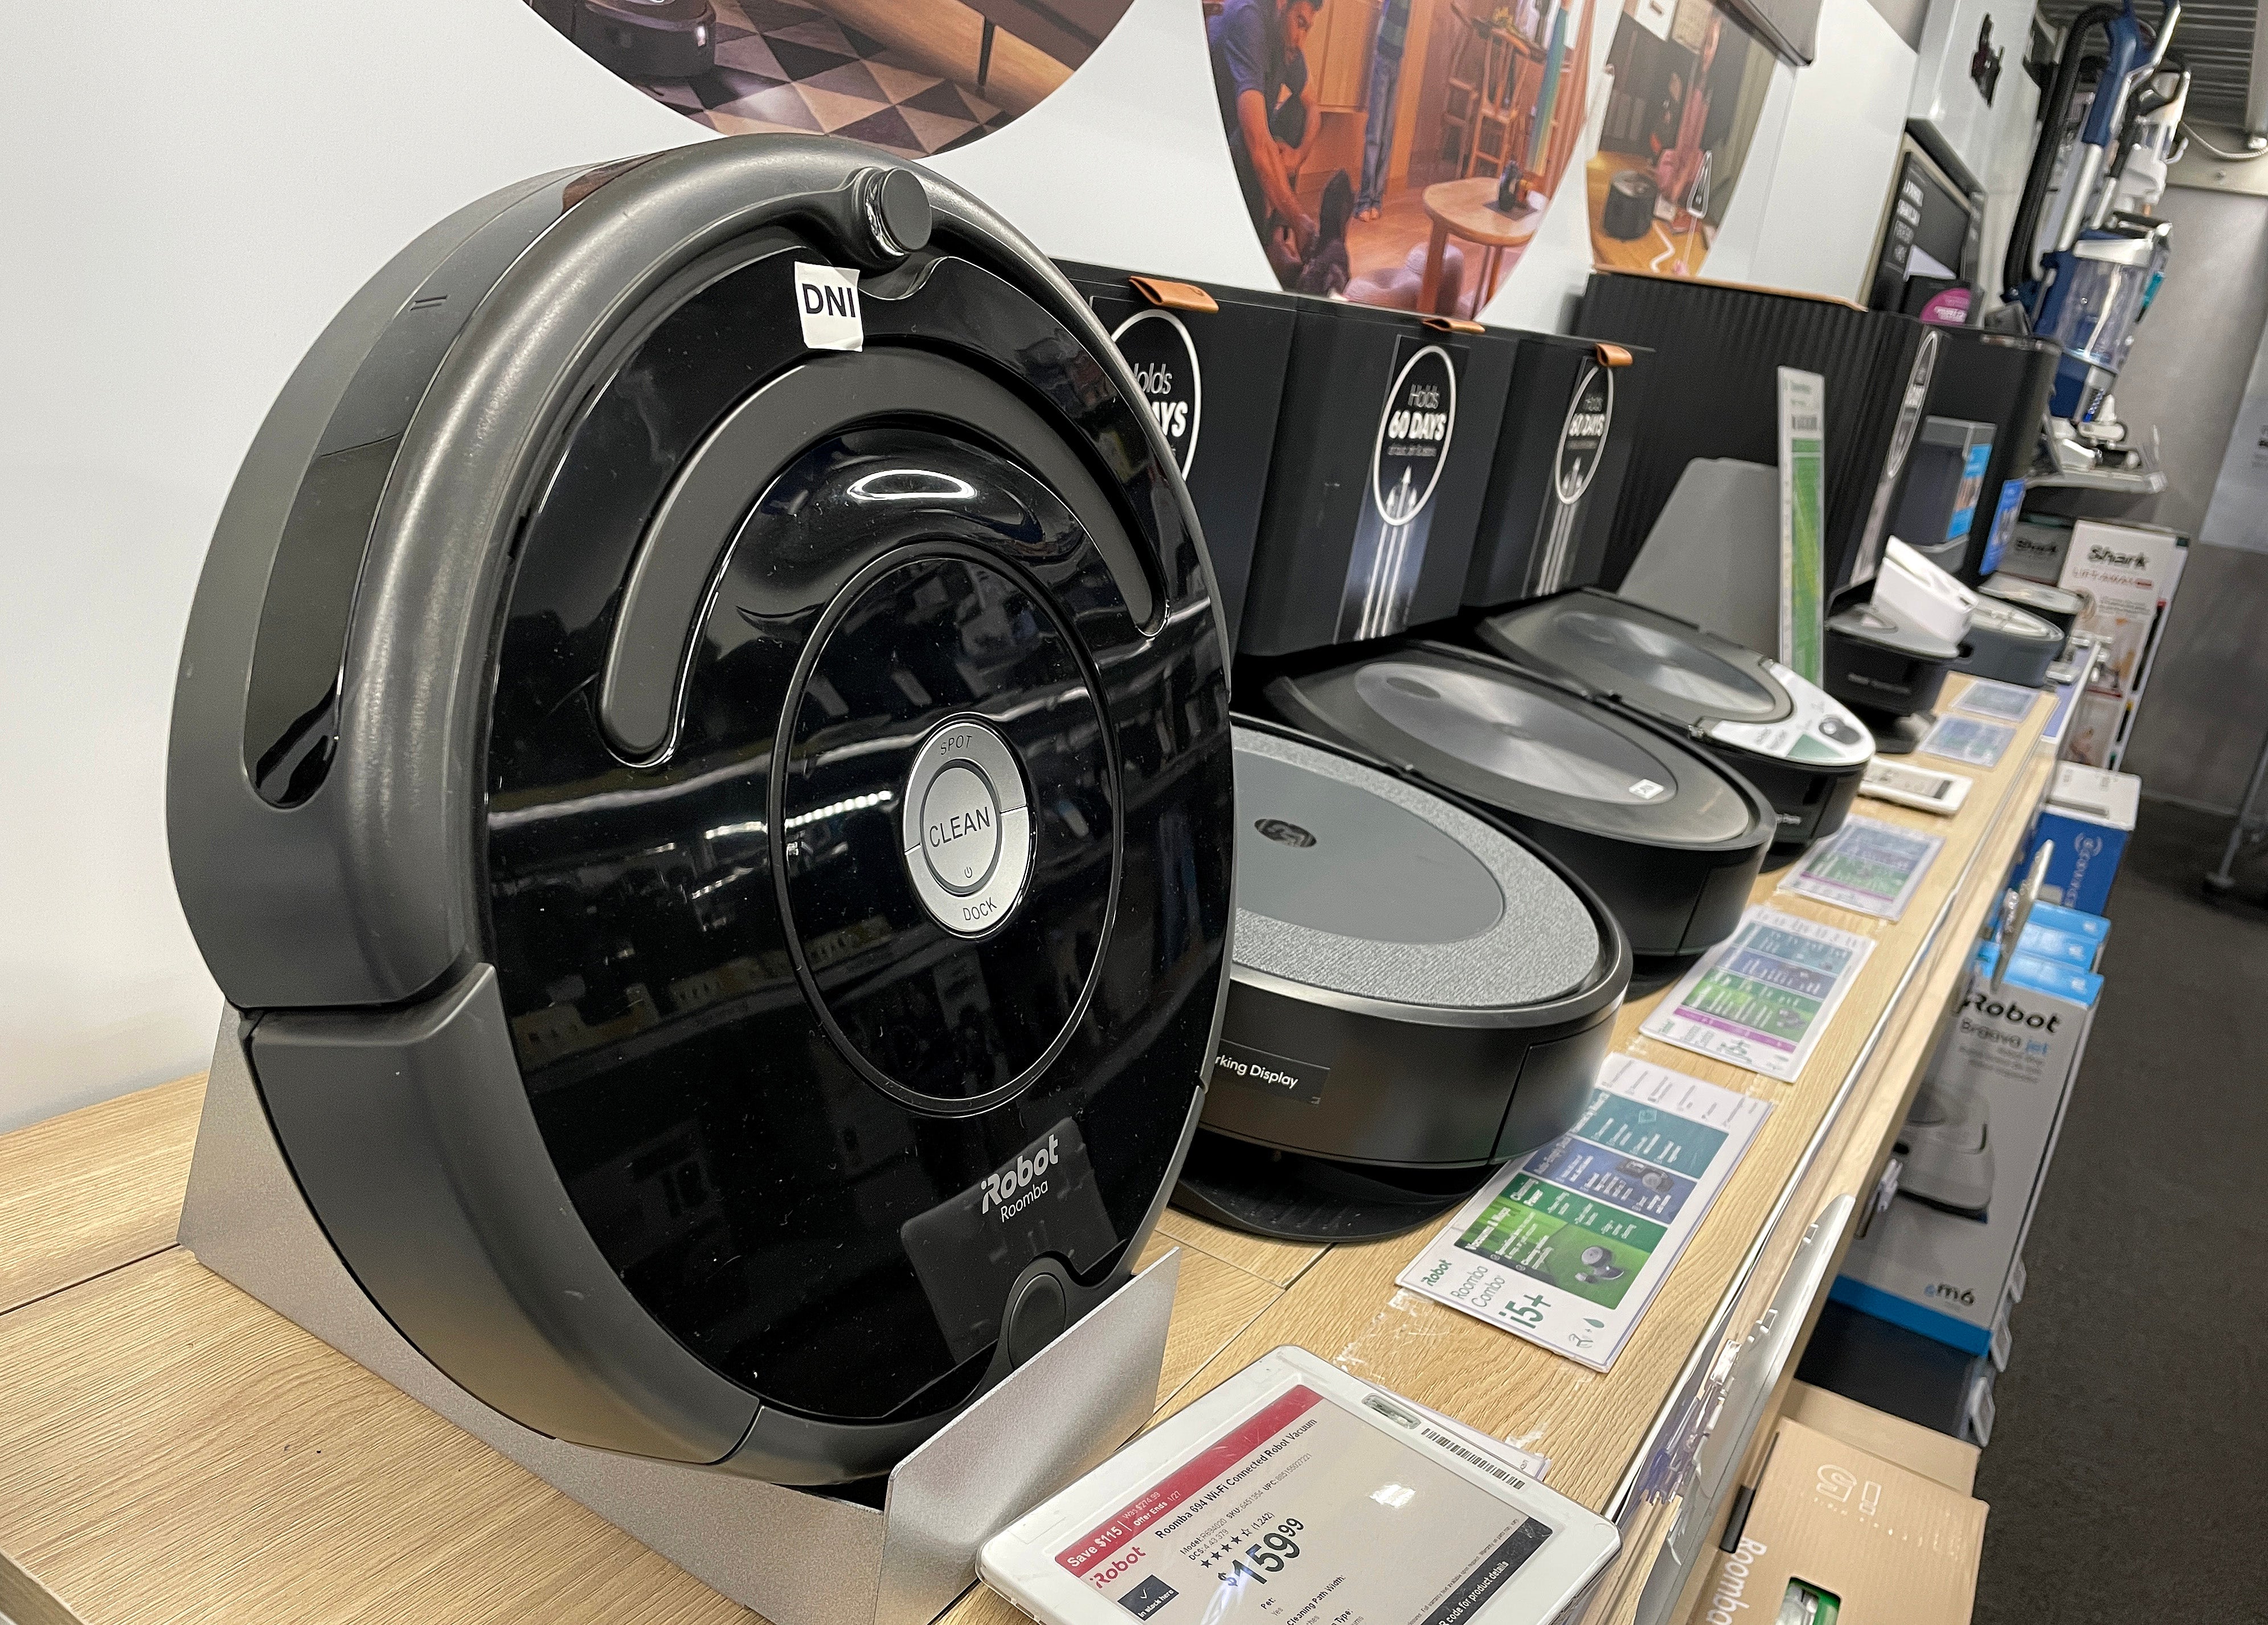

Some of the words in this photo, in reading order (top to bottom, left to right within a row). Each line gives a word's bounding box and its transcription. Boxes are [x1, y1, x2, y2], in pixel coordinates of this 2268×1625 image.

[802, 283, 855, 317] DNI
[1407, 384, 1440, 409] Holds
[1388, 410, 1411, 439] 60
[1408, 411, 1447, 441] DAYS
[1581, 414, 1605, 437] DAYS
[2087, 544, 2150, 570] Shark
[940, 735, 973, 755] SPOT
[929, 806, 990, 848] CLEAN
[962, 897, 997, 921] DOCK
[1214, 1055, 1247, 1076] rking
[1249, 1065, 1299, 1088] Display
[980, 1133, 1059, 1214] iRobot
[1000, 1180, 1049, 1223] Roomba
[1420, 1259, 1452, 1287] iRobot
[1450, 1266, 1488, 1300] Roomba
[1499, 1294, 1551, 1329] i5+
[1155, 1511, 1193, 1538] Roomba
[1189, 1499, 1208, 1513] 694
[1203, 1483, 1229, 1501] Wi-Fi
[1226, 1454, 1268, 1486] Connected
[1264, 1439, 1290, 1458] Robot
[1286, 1418, 1317, 1440] Vacuum
[1122, 1509, 1137, 1520] Was
[1136, 1492, 1161, 1511] $274.99
[1133, 1513, 1151, 1526] Offer
[1149, 1501, 1168, 1515] Ends
[1167, 1490, 1181, 1503] 1/27
[1067, 1546, 1098, 1567] Save
[1095, 1526, 1123, 1548] $115
[1090, 1546, 1146, 1589] iRobot
[1706, 1537, 1767, 1625] Roomba
[1144, 1598, 1162, 1612] stock
[1159, 1589, 1174, 1601] here
[1260, 1597, 1276, 1610] Pet:
[1287, 1602, 1316, 1625] Cleaning
[1312, 1590, 1328, 1604] Path
[1446, 1607, 1463, 1623] code
[1459, 1598, 1471, 1609] for
[1468, 1577, 1493, 1602] product
[1489, 1561, 1509, 1579] details
[1271, 1607, 1284, 1616] Yes
